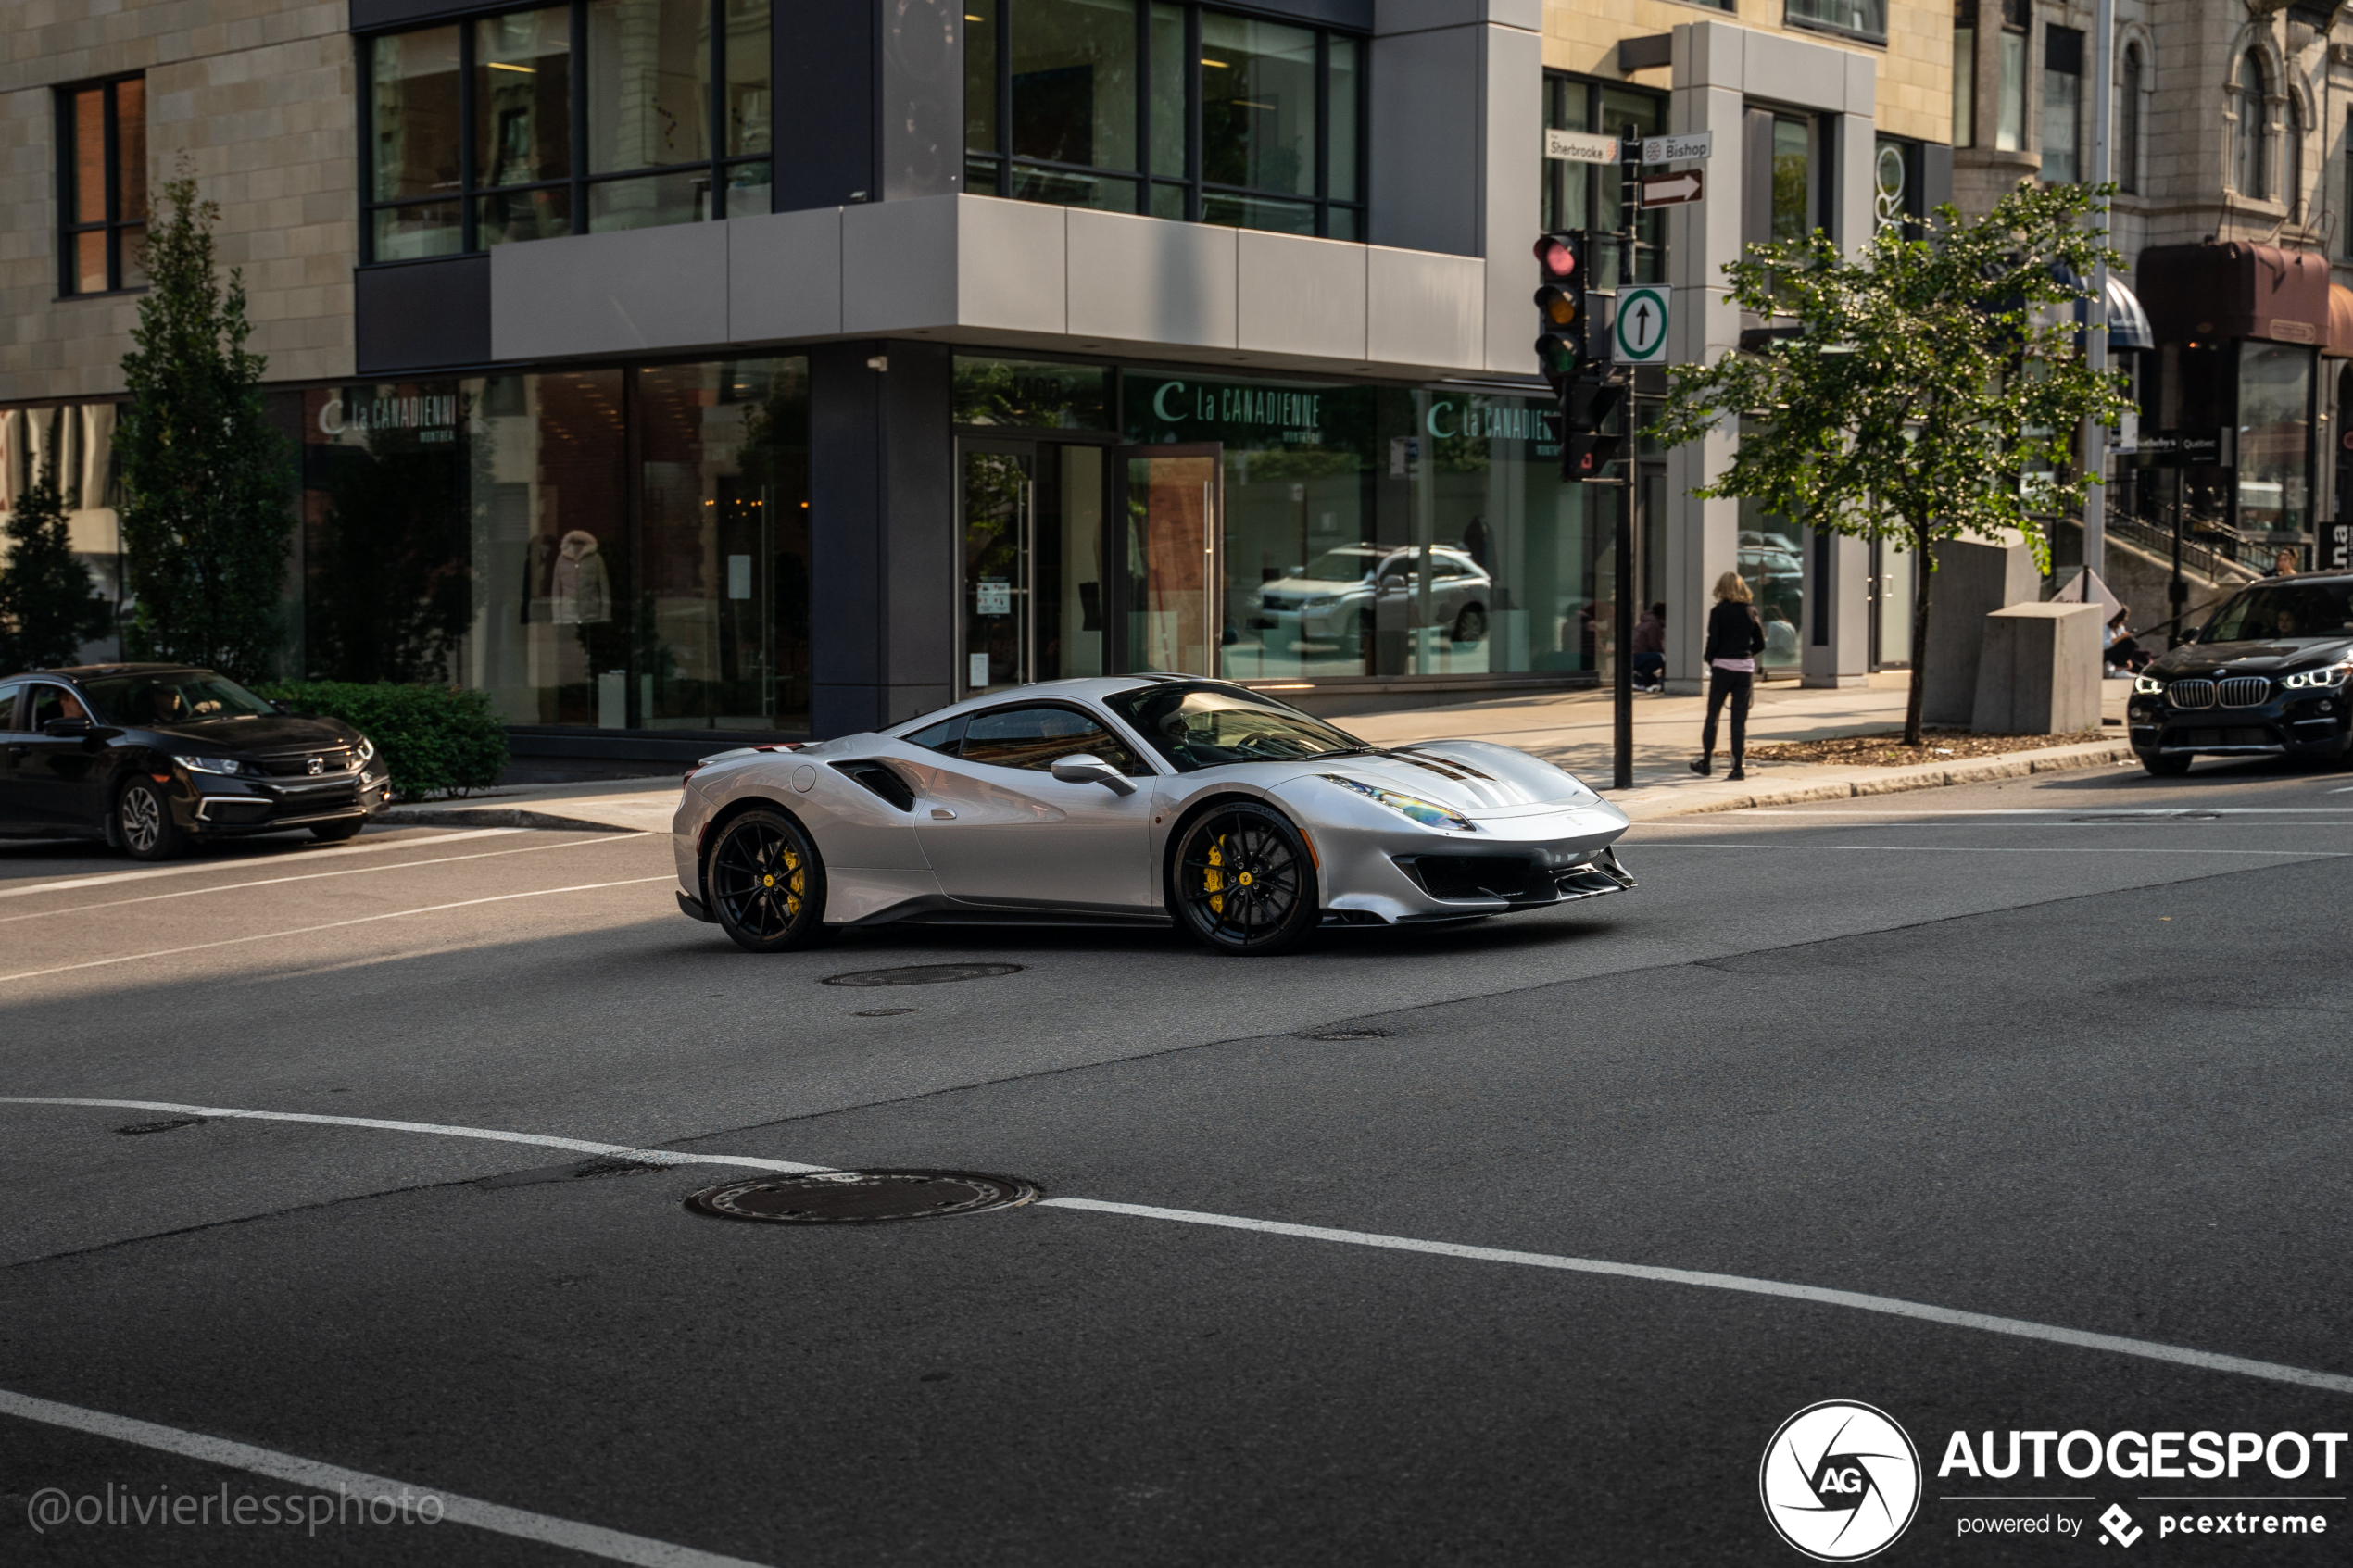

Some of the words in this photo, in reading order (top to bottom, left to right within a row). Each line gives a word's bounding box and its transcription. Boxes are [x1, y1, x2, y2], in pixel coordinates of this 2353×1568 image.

[1551, 141, 1604, 159] Sherbrooke
[1667, 143, 1706, 158] Bishop
[1222, 388, 1321, 428] CANADIENNE
[2333, 524, 2349, 571] na
